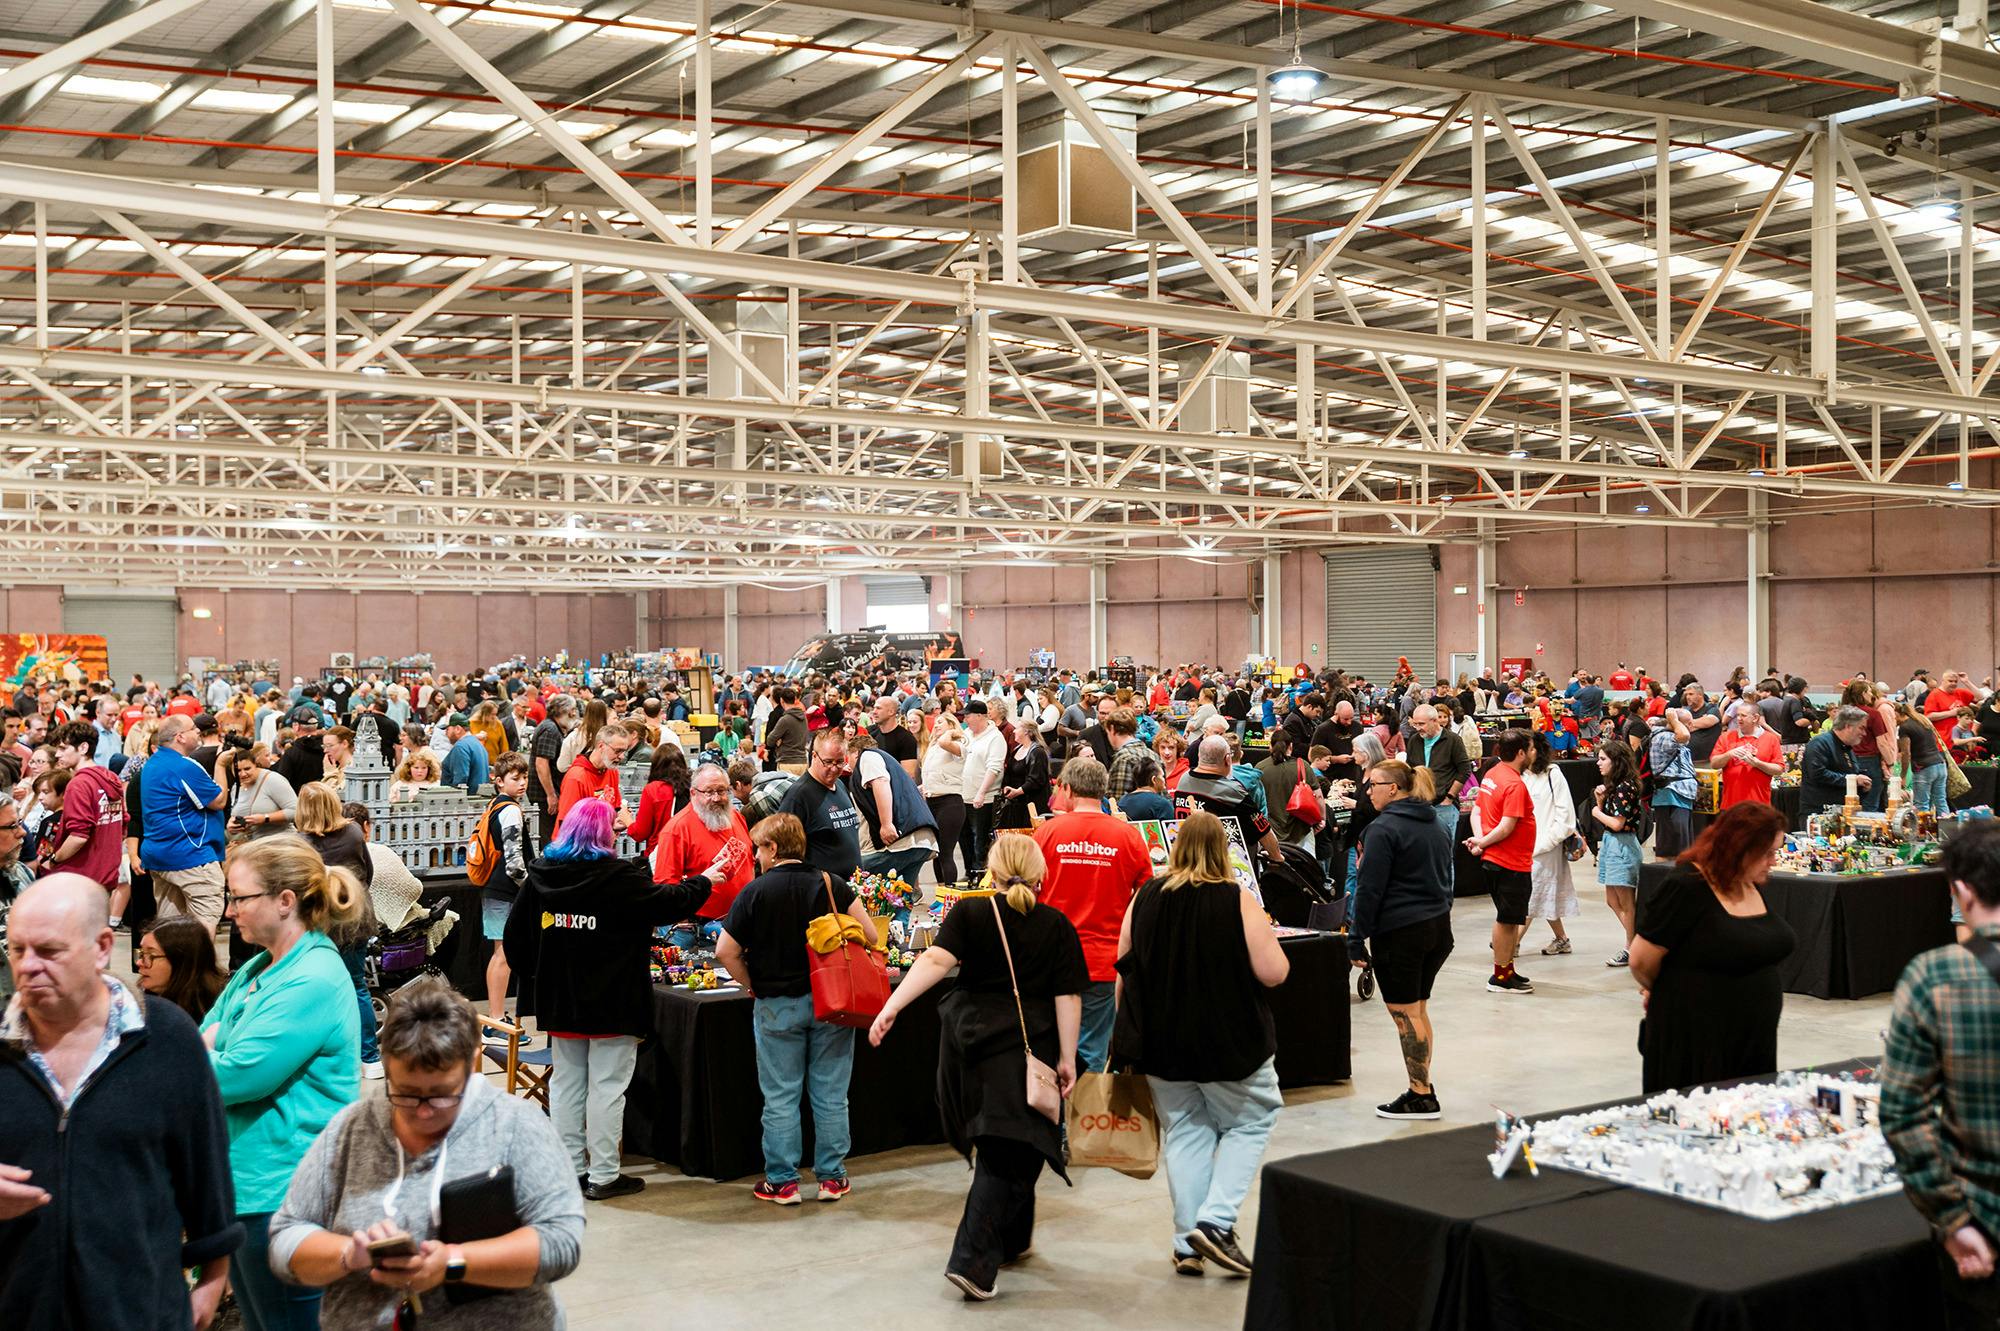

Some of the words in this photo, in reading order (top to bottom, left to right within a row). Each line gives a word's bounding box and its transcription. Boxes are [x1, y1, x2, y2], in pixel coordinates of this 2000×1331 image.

[1175, 798, 1206, 810] BROK
[1056, 841, 1118, 857] exhibitor
[1081, 1111, 1142, 1132] coles
